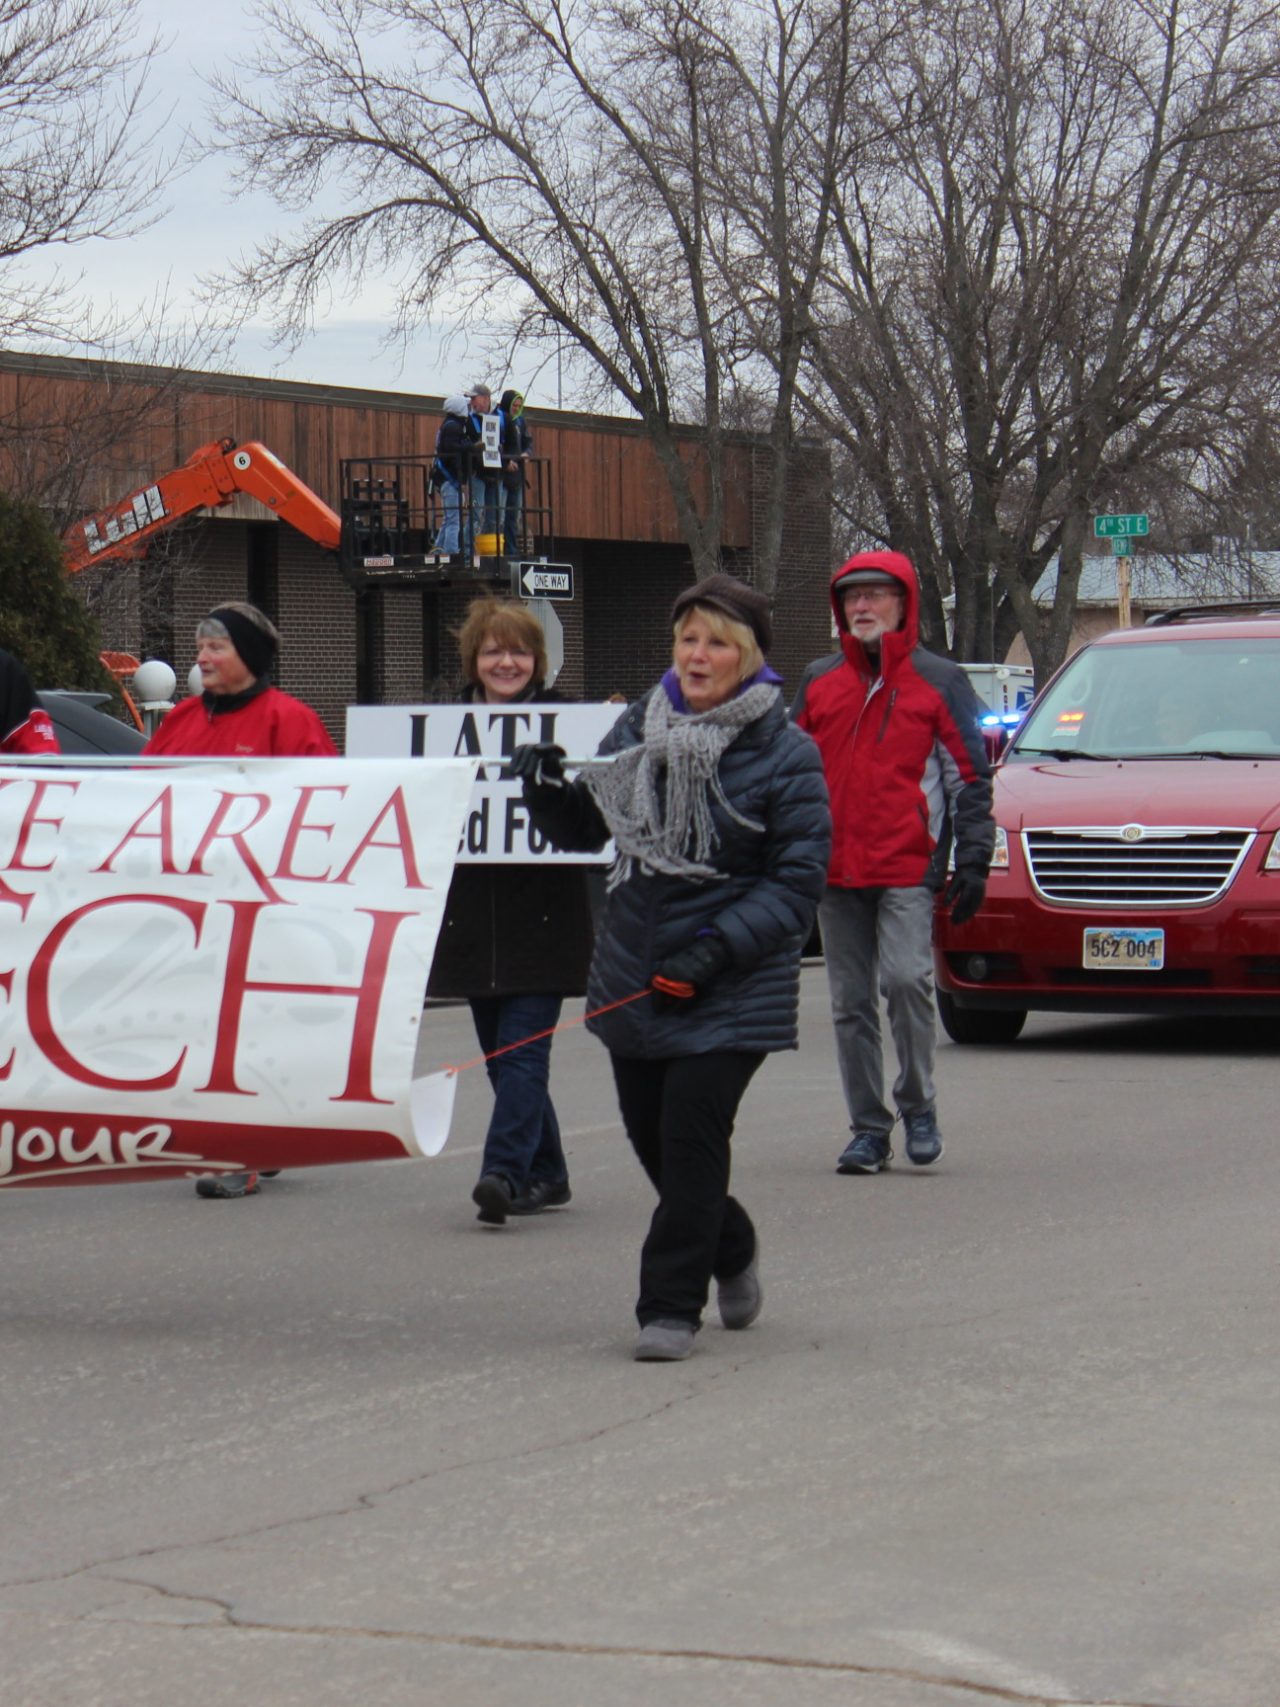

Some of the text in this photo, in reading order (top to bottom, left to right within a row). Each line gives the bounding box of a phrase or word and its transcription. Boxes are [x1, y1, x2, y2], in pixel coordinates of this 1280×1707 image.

[238, 456, 246, 465] 6
[1117, 517, 1131, 533] ST
[1136, 517, 1144, 532] E
[534, 574, 566, 588] ONE WAY
[89, 784, 433, 904] AREA
[1091, 940, 1156, 958] 5C2 004
